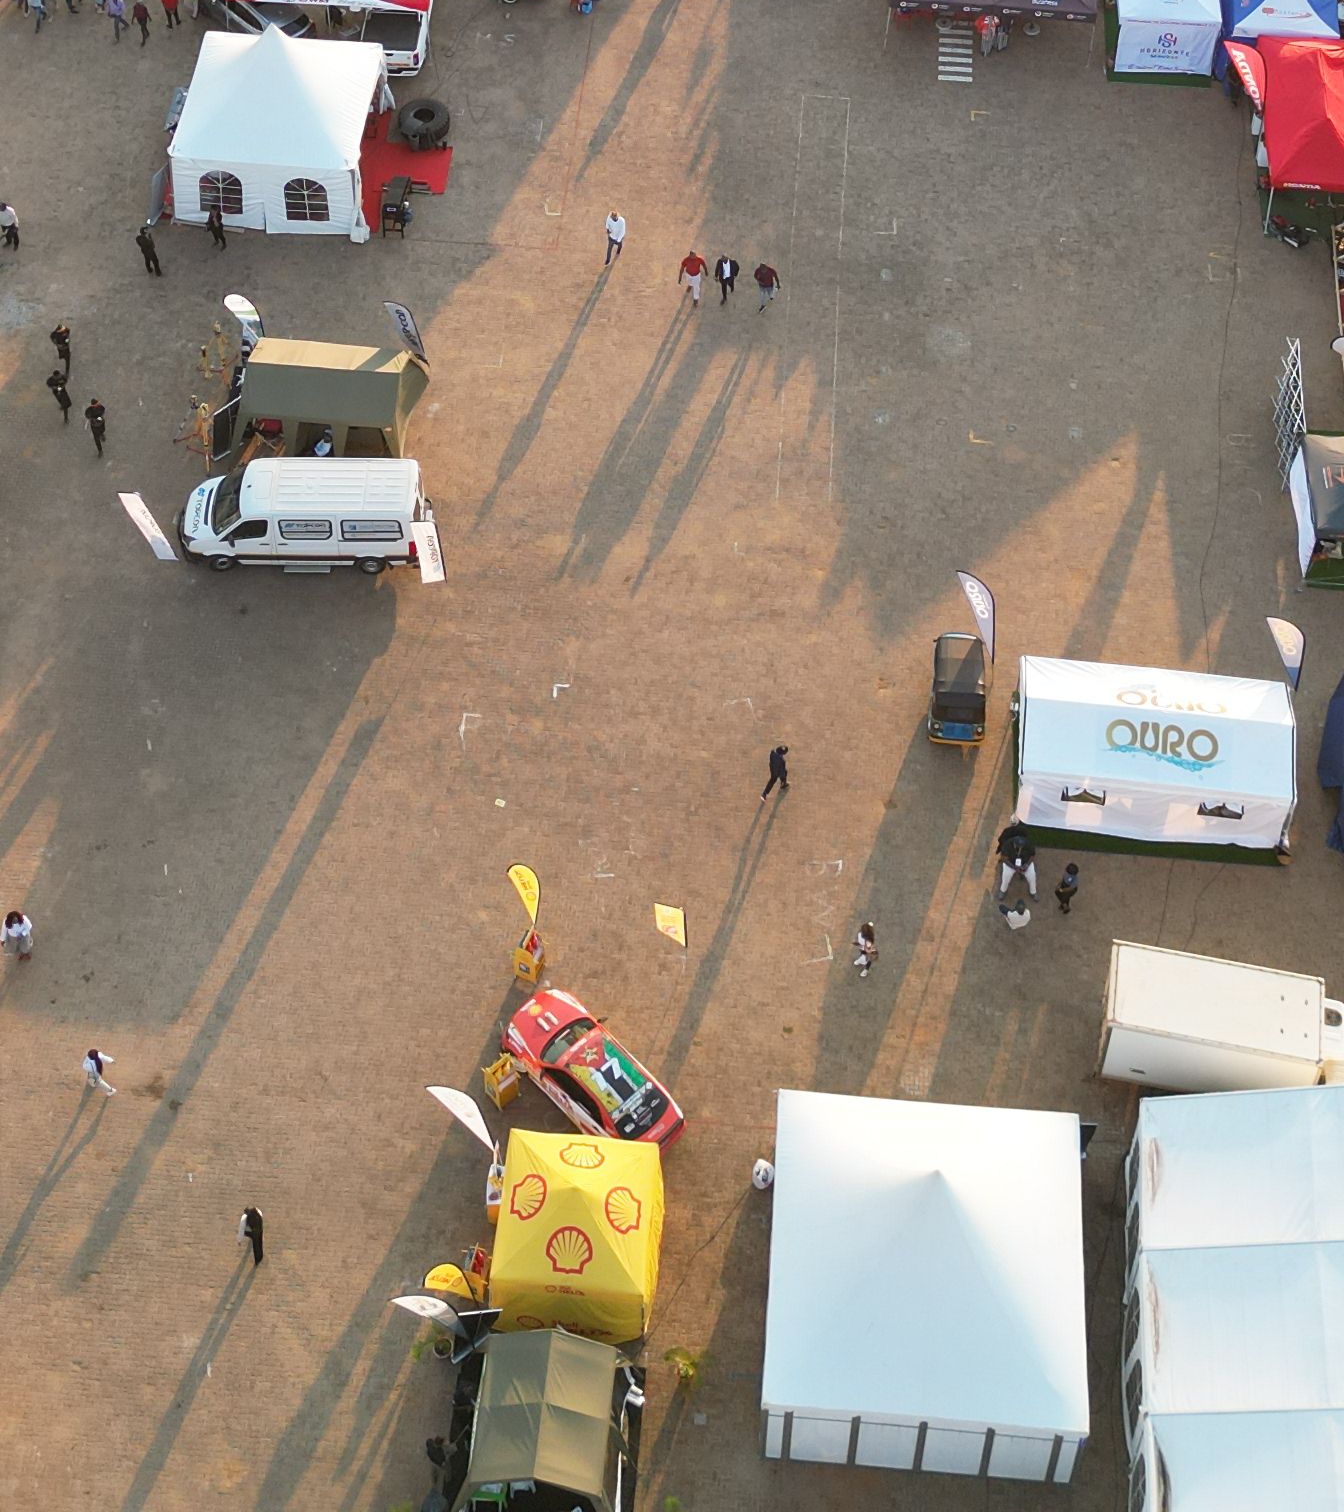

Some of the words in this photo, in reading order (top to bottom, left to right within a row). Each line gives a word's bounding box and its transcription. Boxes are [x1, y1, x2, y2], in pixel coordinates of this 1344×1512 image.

[1140, 48, 1190, 57] HORIZONTE
[1283, 182, 1321, 190] HONDA
[1106, 719, 1219, 761] OURO
